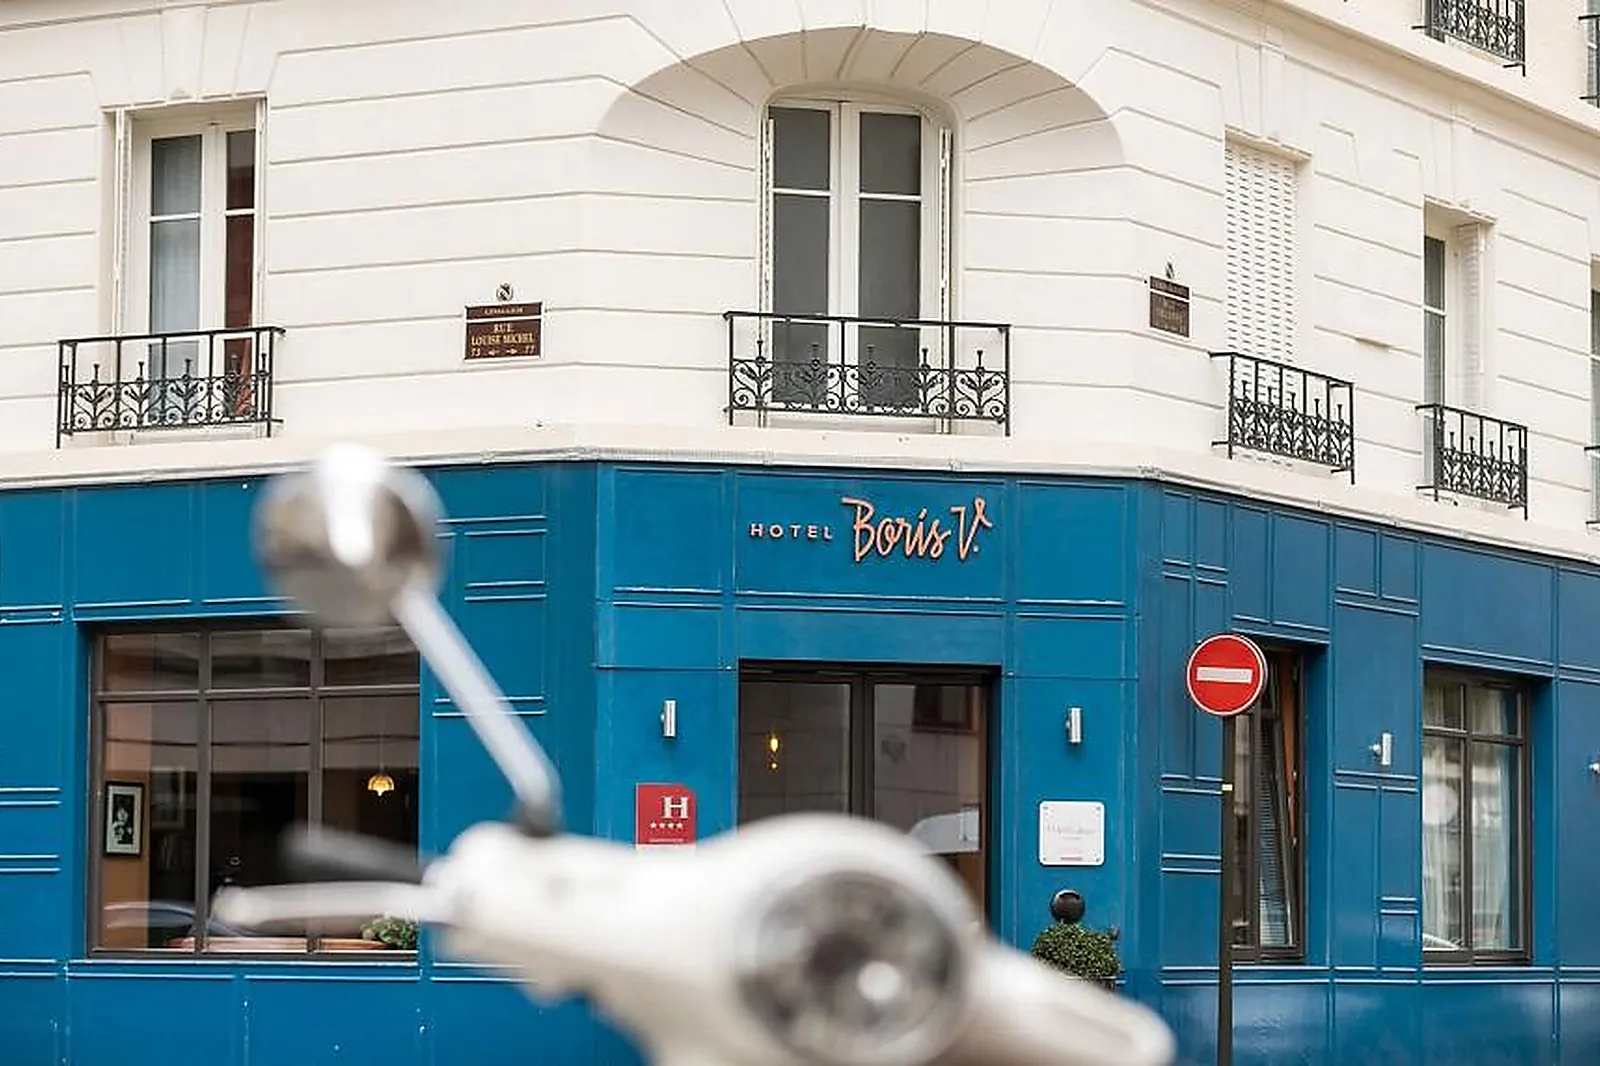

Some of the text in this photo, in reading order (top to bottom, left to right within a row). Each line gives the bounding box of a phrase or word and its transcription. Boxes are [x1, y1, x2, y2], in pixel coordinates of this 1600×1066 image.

[494, 323, 513, 334] RUE
[471, 332, 534, 346] LOUISE MICHEL
[750, 523, 833, 539] HOTEL
[841, 497, 951, 562] Boris
[661, 795, 688, 818] H
